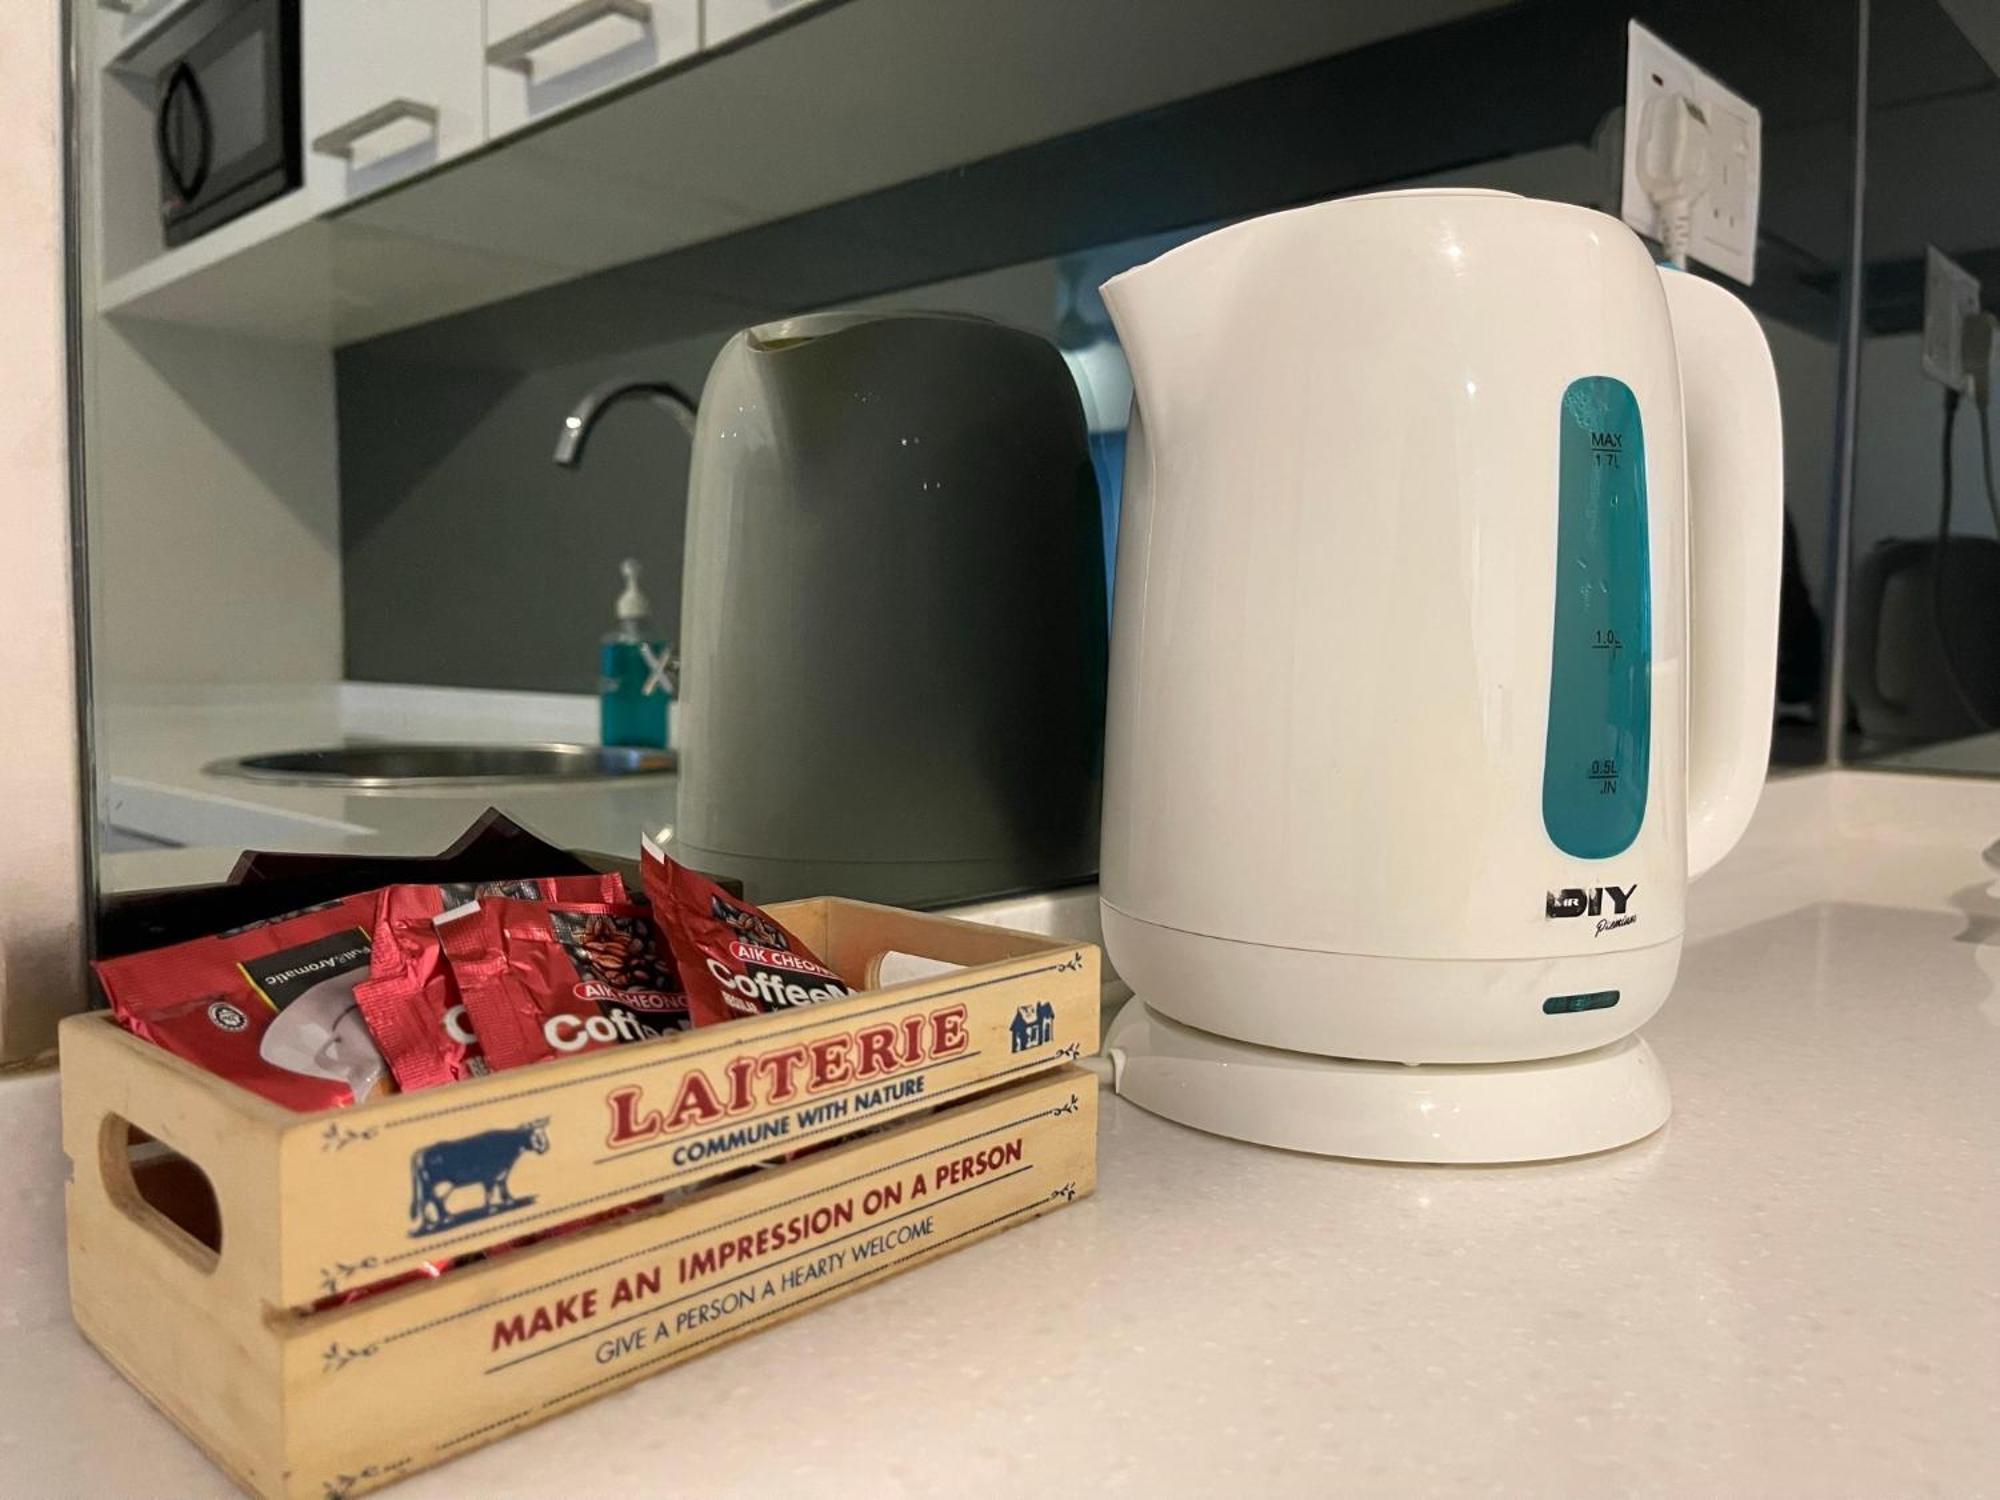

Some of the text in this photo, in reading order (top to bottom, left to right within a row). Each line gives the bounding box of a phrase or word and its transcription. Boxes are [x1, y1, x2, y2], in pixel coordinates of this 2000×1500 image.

[1592, 432, 1622, 448] MAX
[1596, 453, 1621, 469] 17L
[1591, 760, 1619, 774] 0.5L
[1600, 780, 1617, 795] IN
[737, 946, 834, 976] AIK CHEON
[607, 1003, 970, 1149] LAITERIE
[672, 1075, 926, 1166] COMMUNE WITH NATURE
[490, 1138, 1024, 1353] MAKE AN IMPRESSION ON A PERSON
[594, 1215, 935, 1365] GIVE A PERSON A HEARTY WELCOME
